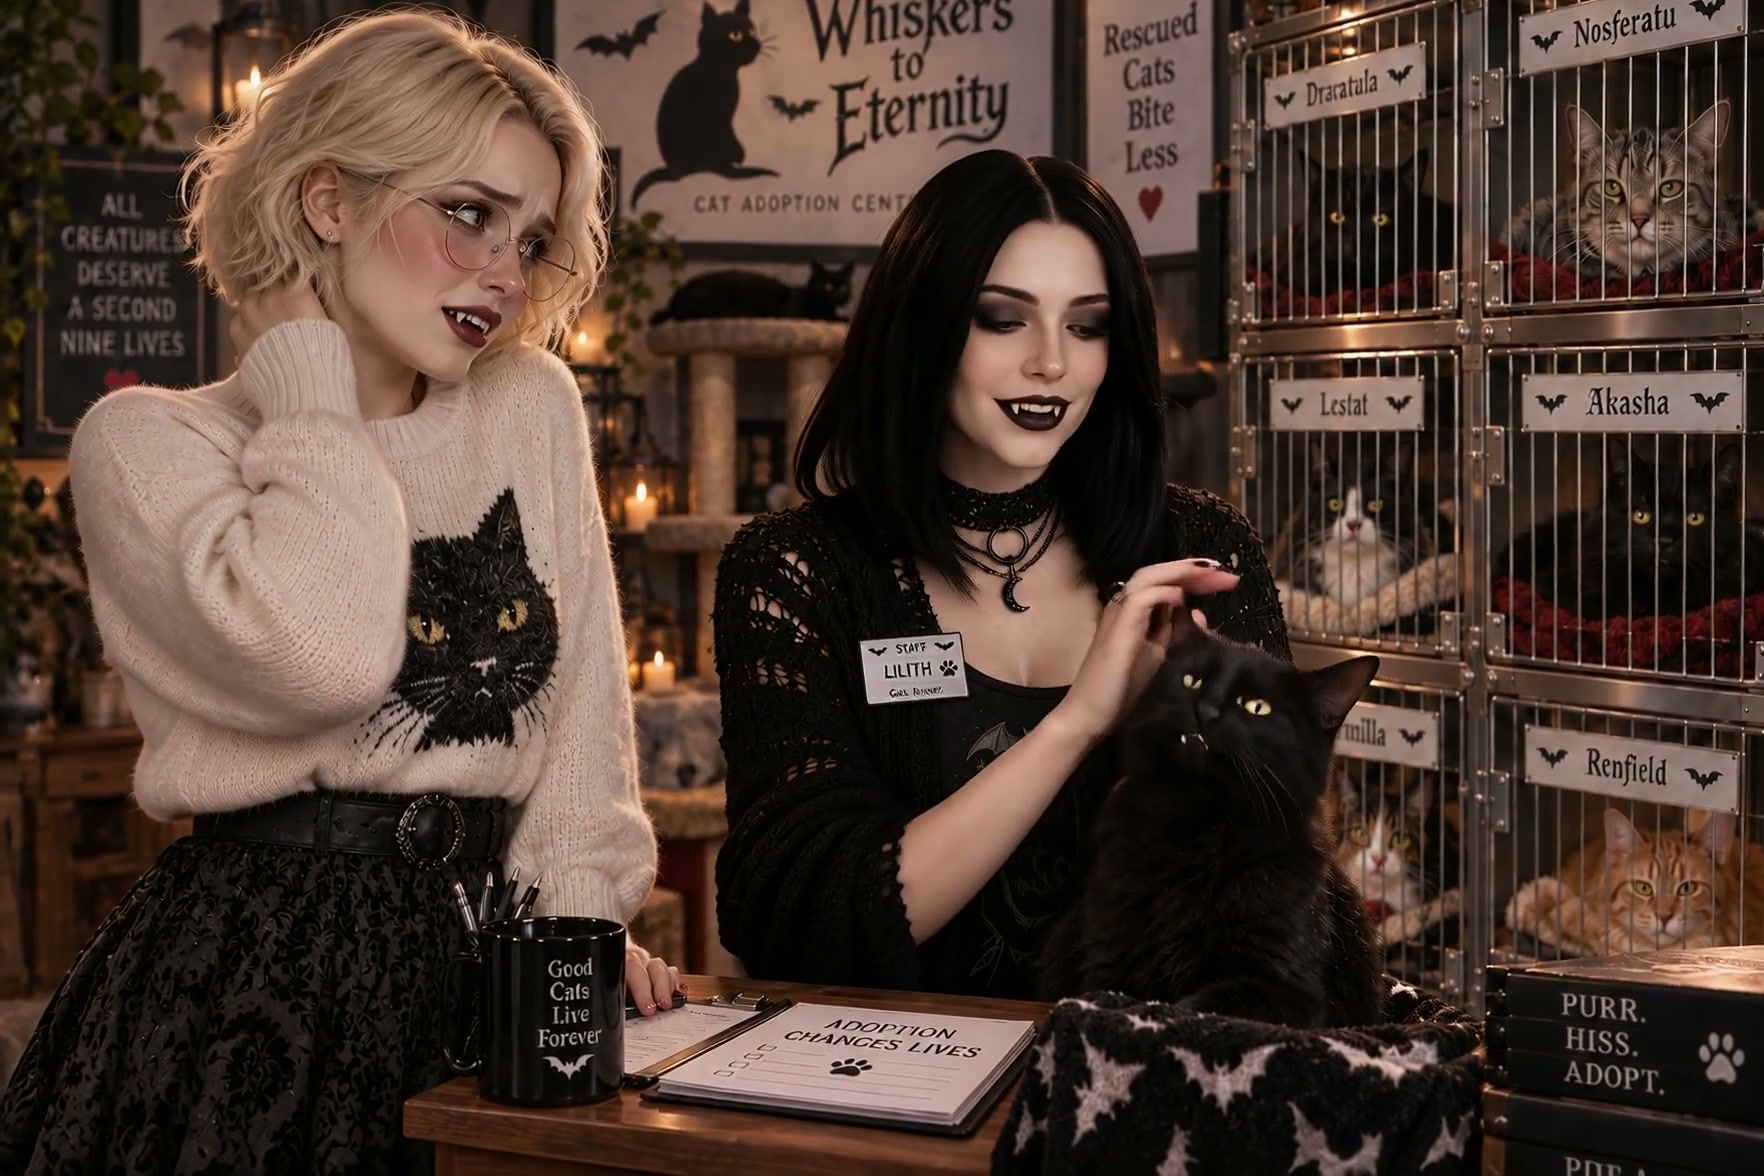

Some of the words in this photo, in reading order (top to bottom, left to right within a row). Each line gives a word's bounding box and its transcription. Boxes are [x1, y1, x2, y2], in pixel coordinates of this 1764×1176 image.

[806, 0, 1014, 63] Whiskers
[1103, 1, 1199, 56] Rescued
[1573, 4, 1677, 48] Nosferatu
[890, 47, 925, 82] to
[1122, 56, 1175, 92] Cats
[827, 73, 1010, 178] Eternity
[1127, 97, 1175, 132] Bite
[1125, 140, 1179, 174] Less
[101, 193, 143, 219] ALL
[693, 195, 732, 213] CAT
[741, 194, 840, 213] ADOPTION
[851, 194, 914, 213] CENT
[77, 260, 171, 288] DESERVE
[67, 295, 84, 320] A
[91, 296, 178, 322] SECOND
[60, 329, 117, 356] NINE
[123, 330, 186, 357] LIVES
[1320, 392, 1368, 416] Lestat
[1585, 386, 1670, 416] Akasha
[896, 642, 926, 654] STAFF
[884, 661, 932, 679] LILITH
[1585, 748, 1667, 787] Renfield
[548, 957, 593, 978] Good
[550, 981, 590, 1001] Cats
[552, 1006, 590, 1025] Live
[1560, 992, 1647, 1024] PURR.
[537, 1029, 602, 1049] Forever
[824, 1019, 958, 1039] ADOPTION
[1565, 1026, 1639, 1057] HISS.
[784, 1030, 903, 1051] CHANGES
[907, 1042, 982, 1058] LIVES
[1564, 1060, 1665, 1096] ADOPT.
